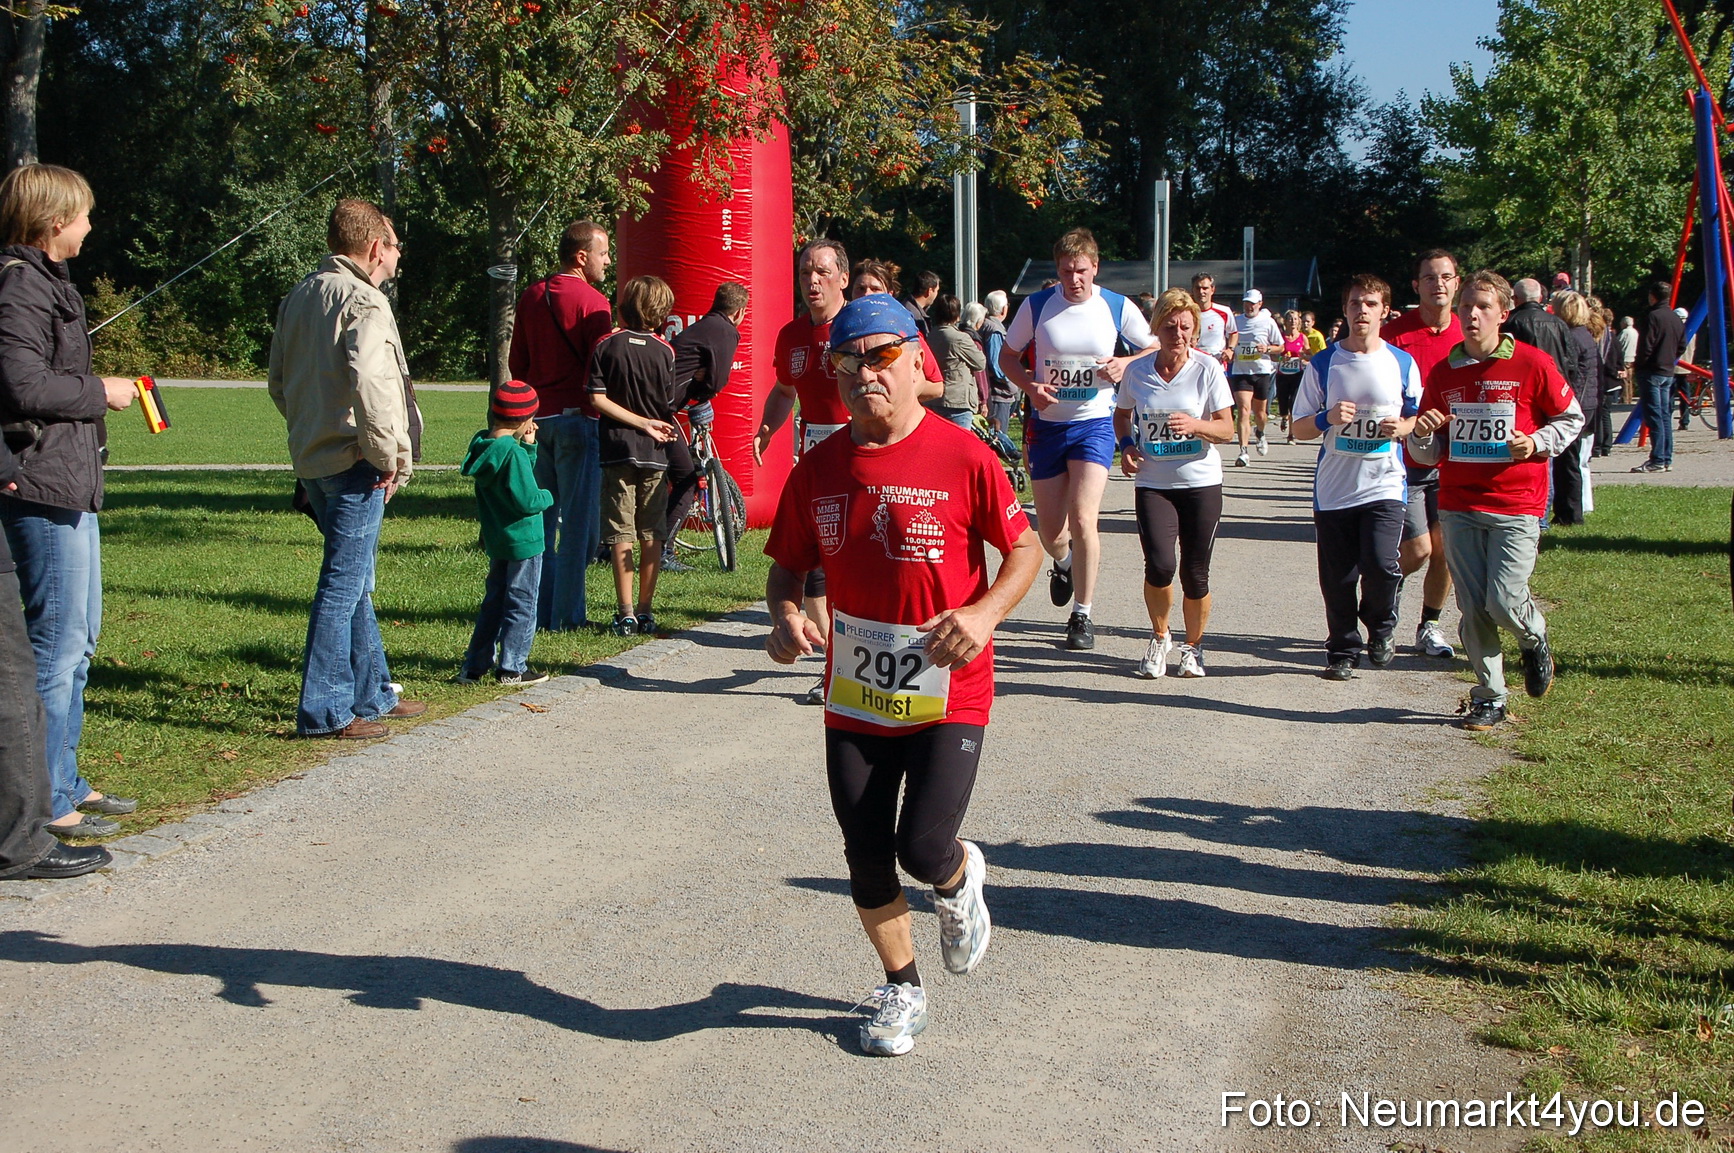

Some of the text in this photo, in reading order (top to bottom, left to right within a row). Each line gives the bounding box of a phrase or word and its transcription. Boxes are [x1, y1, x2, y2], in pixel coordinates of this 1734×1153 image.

[722, 209, 732, 250] Seit 1929
[1049, 368, 1093, 387] 2949
[1055, 388, 1087, 399] Harald
[1455, 418, 1507, 441] 2758
[1152, 442, 1192, 455] Claudia
[1347, 438, 1380, 451] Stefan
[1461, 442, 1498, 455] Daniel
[866, 485, 950, 501] 11. NEUMARKTER
[879, 494, 936, 507] STADTLAUF
[904, 536, 945, 546] 19.09.2010
[846, 623, 895, 643] PFLEIDERER
[853, 645, 923, 692] 292
[861, 685, 912, 717] Horst
